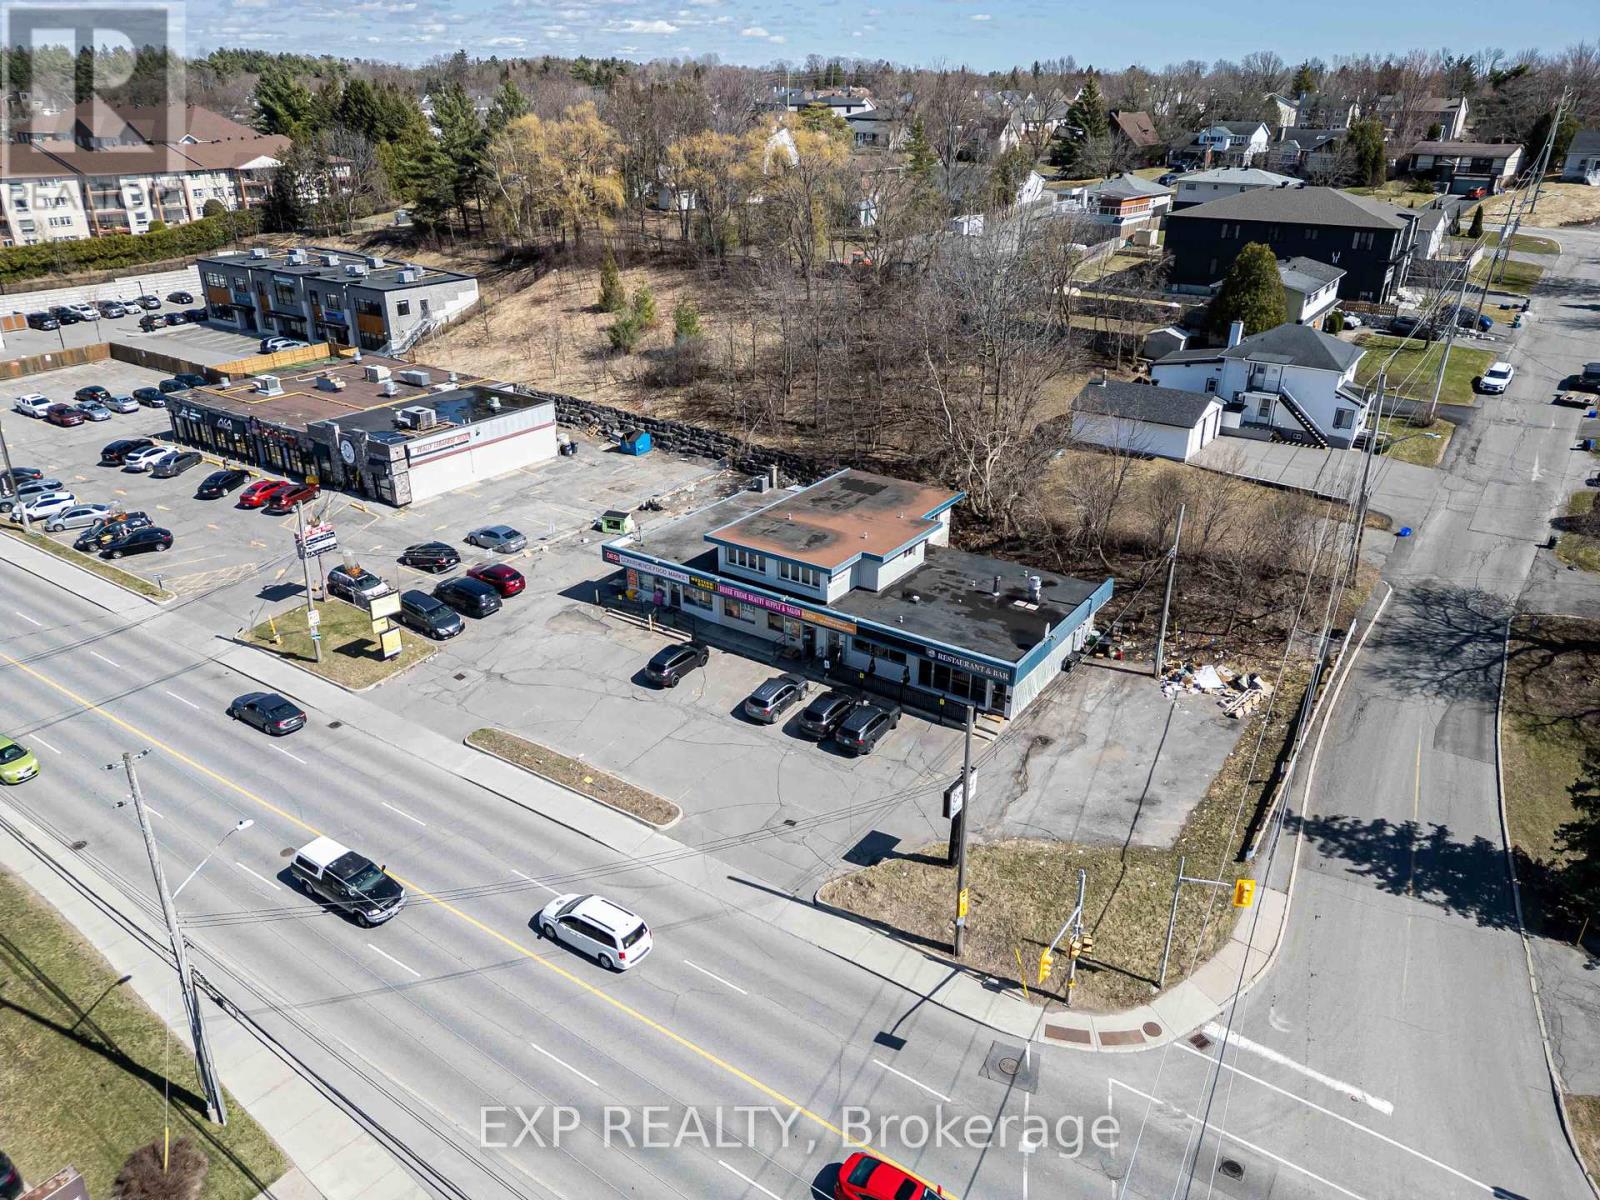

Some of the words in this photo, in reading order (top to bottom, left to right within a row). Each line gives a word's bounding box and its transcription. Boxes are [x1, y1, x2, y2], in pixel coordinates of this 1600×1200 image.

[606, 551, 620, 561] DESI
[748, 594, 765, 606] BEAUTY
[937, 652, 985, 673] RESTAURANT
[985, 667, 992, 675] &
[993, 669, 1009, 681] BAR
